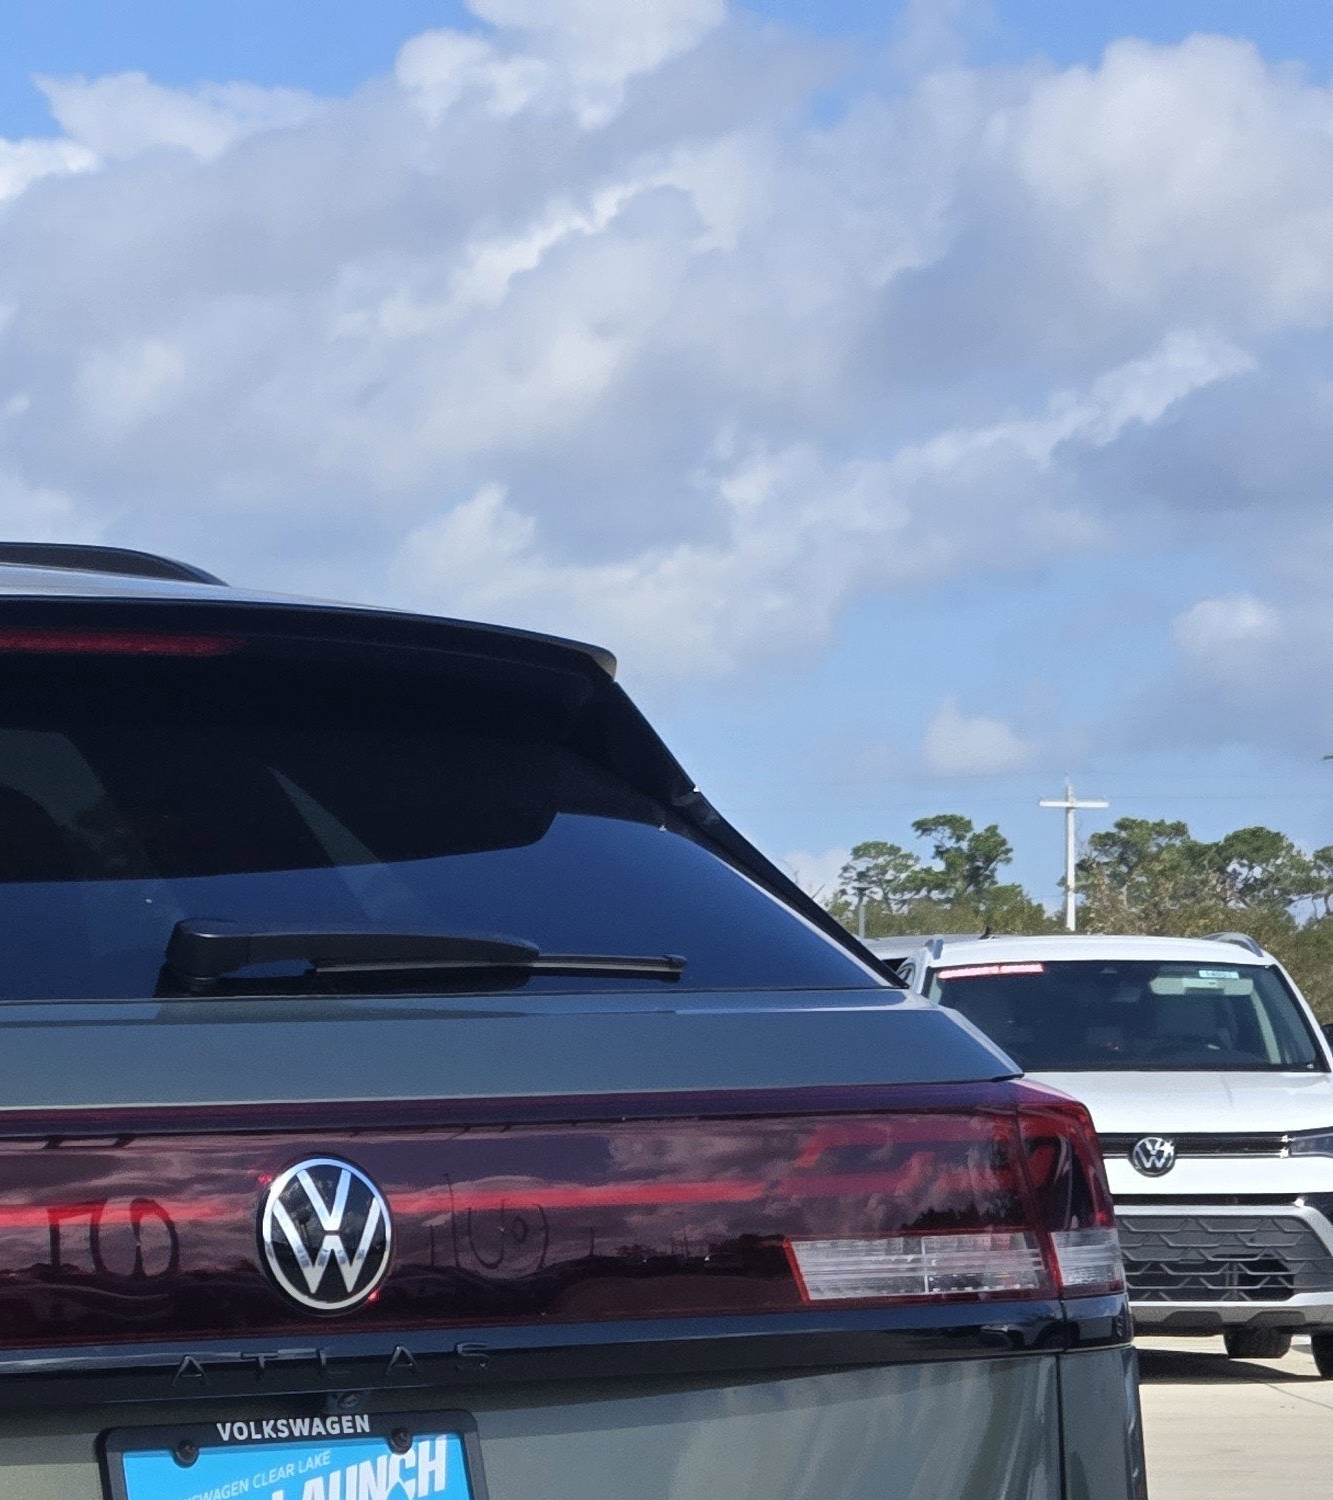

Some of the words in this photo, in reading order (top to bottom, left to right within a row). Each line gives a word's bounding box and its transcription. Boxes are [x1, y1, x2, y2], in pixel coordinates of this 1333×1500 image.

[217, 1414, 371, 1442] VOLKSWAGEN
[253, 1464, 295, 1489] CLEAR
[298, 1450, 332, 1473] LAKE
